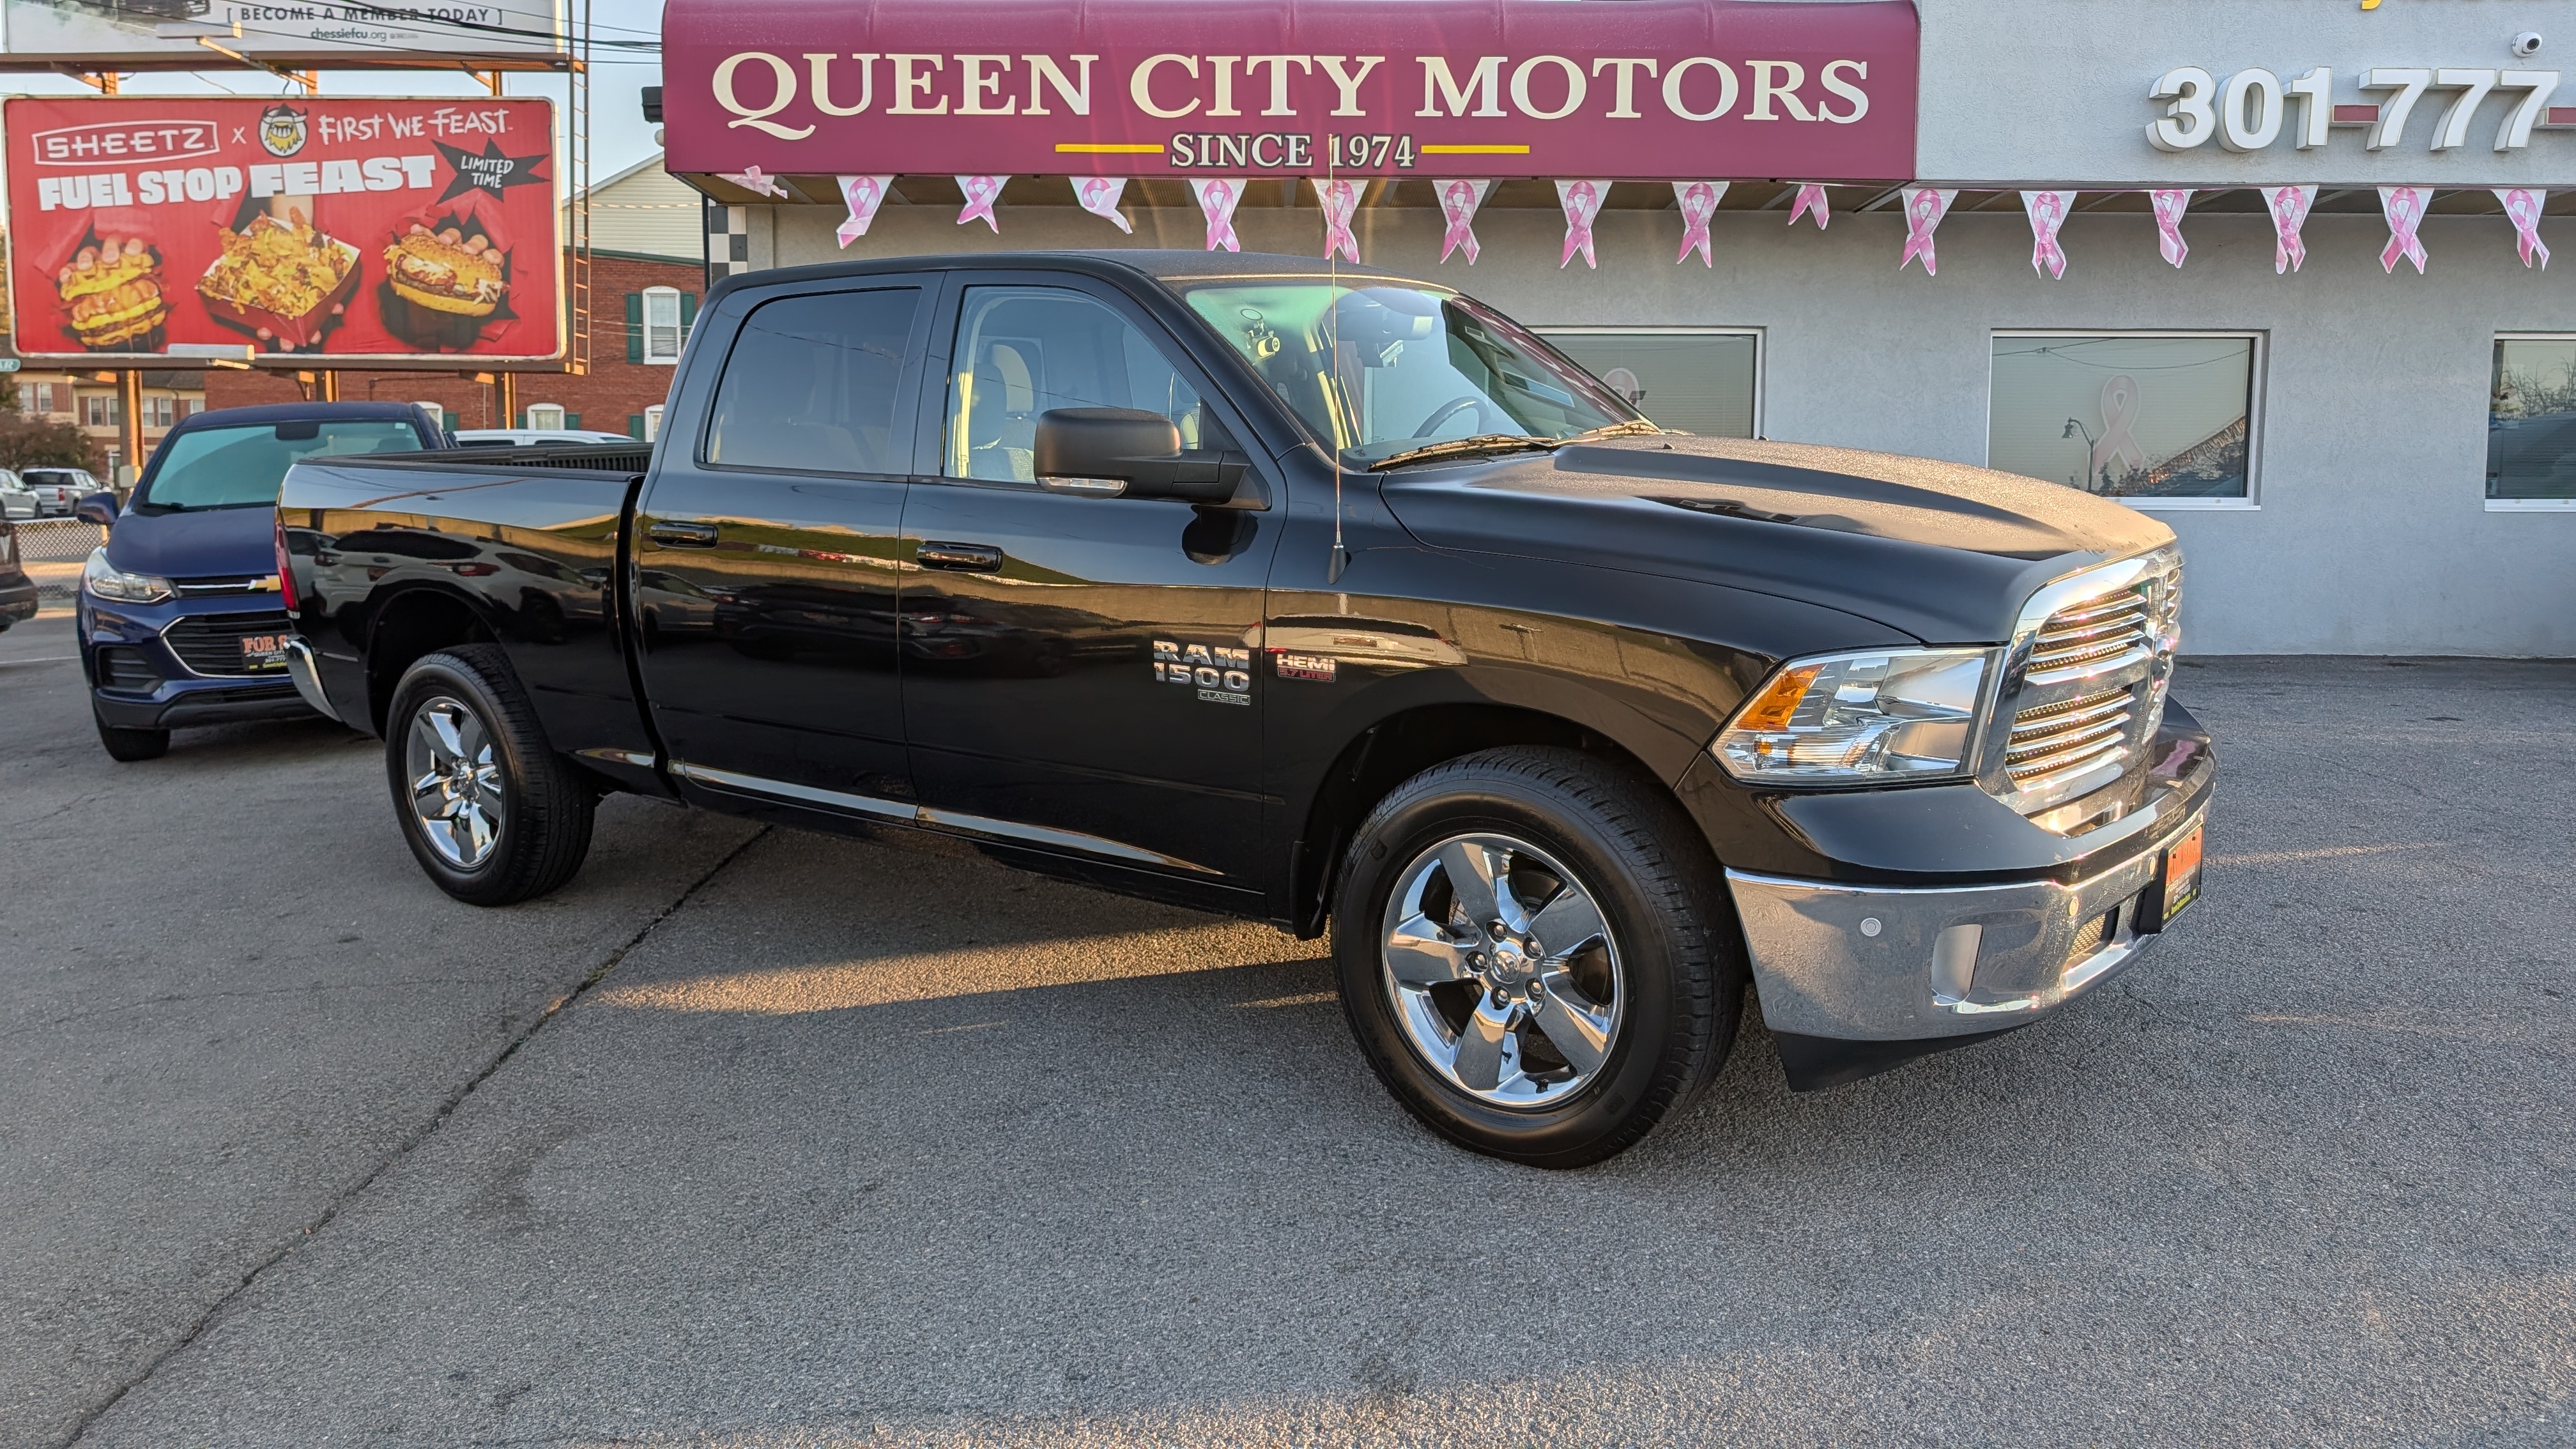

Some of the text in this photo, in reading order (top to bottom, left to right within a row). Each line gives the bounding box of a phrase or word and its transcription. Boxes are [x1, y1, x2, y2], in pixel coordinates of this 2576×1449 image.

[241, 7, 315, 21] BECOME
[323, 7, 336, 20] A
[427, 8, 489, 22] TODAY
[310, 27, 388, 43] chessiefcu.org
[712, 52, 1870, 141] QUEEN CITY MOTORS
[318, 112, 385, 146] FIRST
[387, 112, 424, 139] WE
[45, 127, 206, 159] SHEETZ
[1170, 132, 1416, 169] SINCE 1974
[460, 155, 514, 175] LIMITED
[38, 155, 436, 211] FUEL STOP FEAST
[471, 171, 503, 189] TIME
[242, 636, 276, 654] FOR
[1153, 640, 1250, 670] RAM
[1276, 653, 1335, 671] HEMI
[1153, 661, 1250, 692] 1500
[1279, 667, 1333, 680] 5.7 LITER
[1199, 691, 1250, 704] CLASSIC
